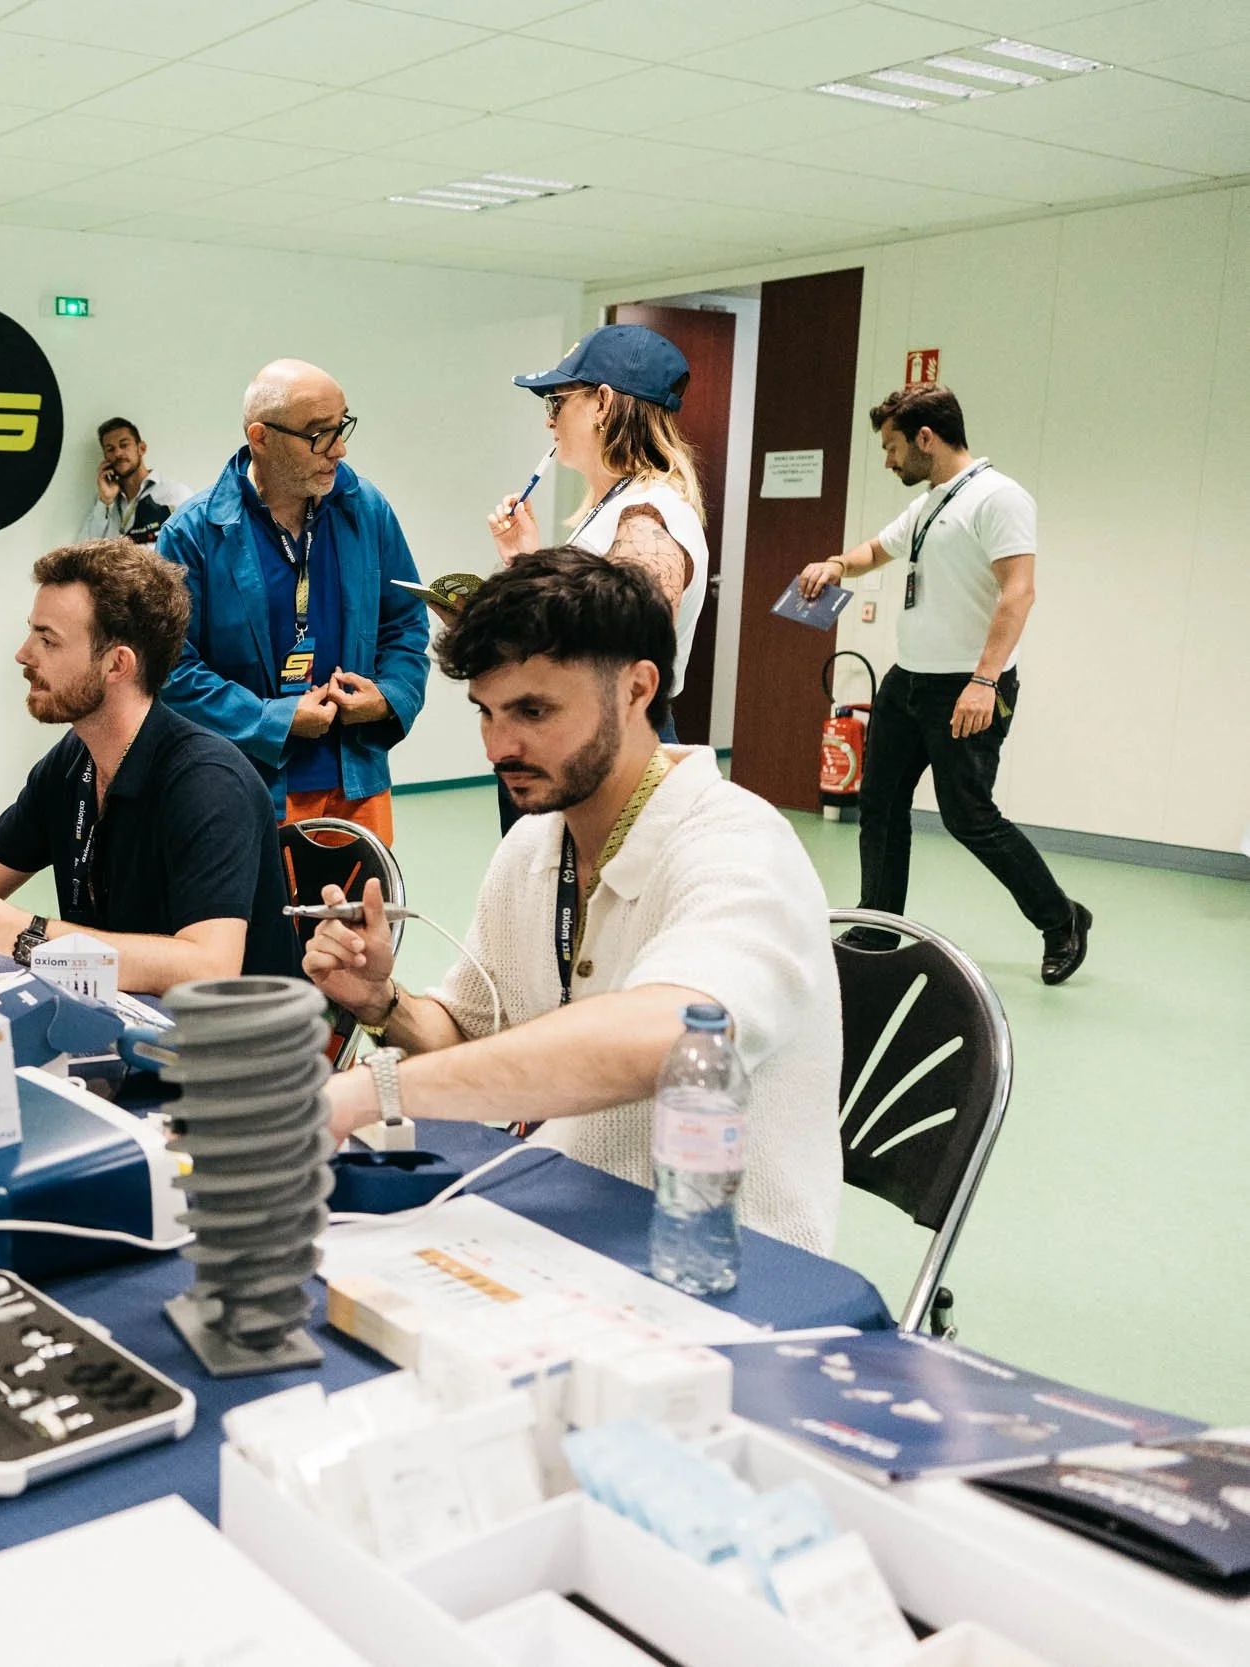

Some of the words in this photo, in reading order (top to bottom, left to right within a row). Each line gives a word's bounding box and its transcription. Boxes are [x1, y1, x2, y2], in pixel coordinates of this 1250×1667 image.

[76, 800, 86, 828] axiom
[562, 908, 571, 940] axiom
[34, 957, 68, 966] axiom
